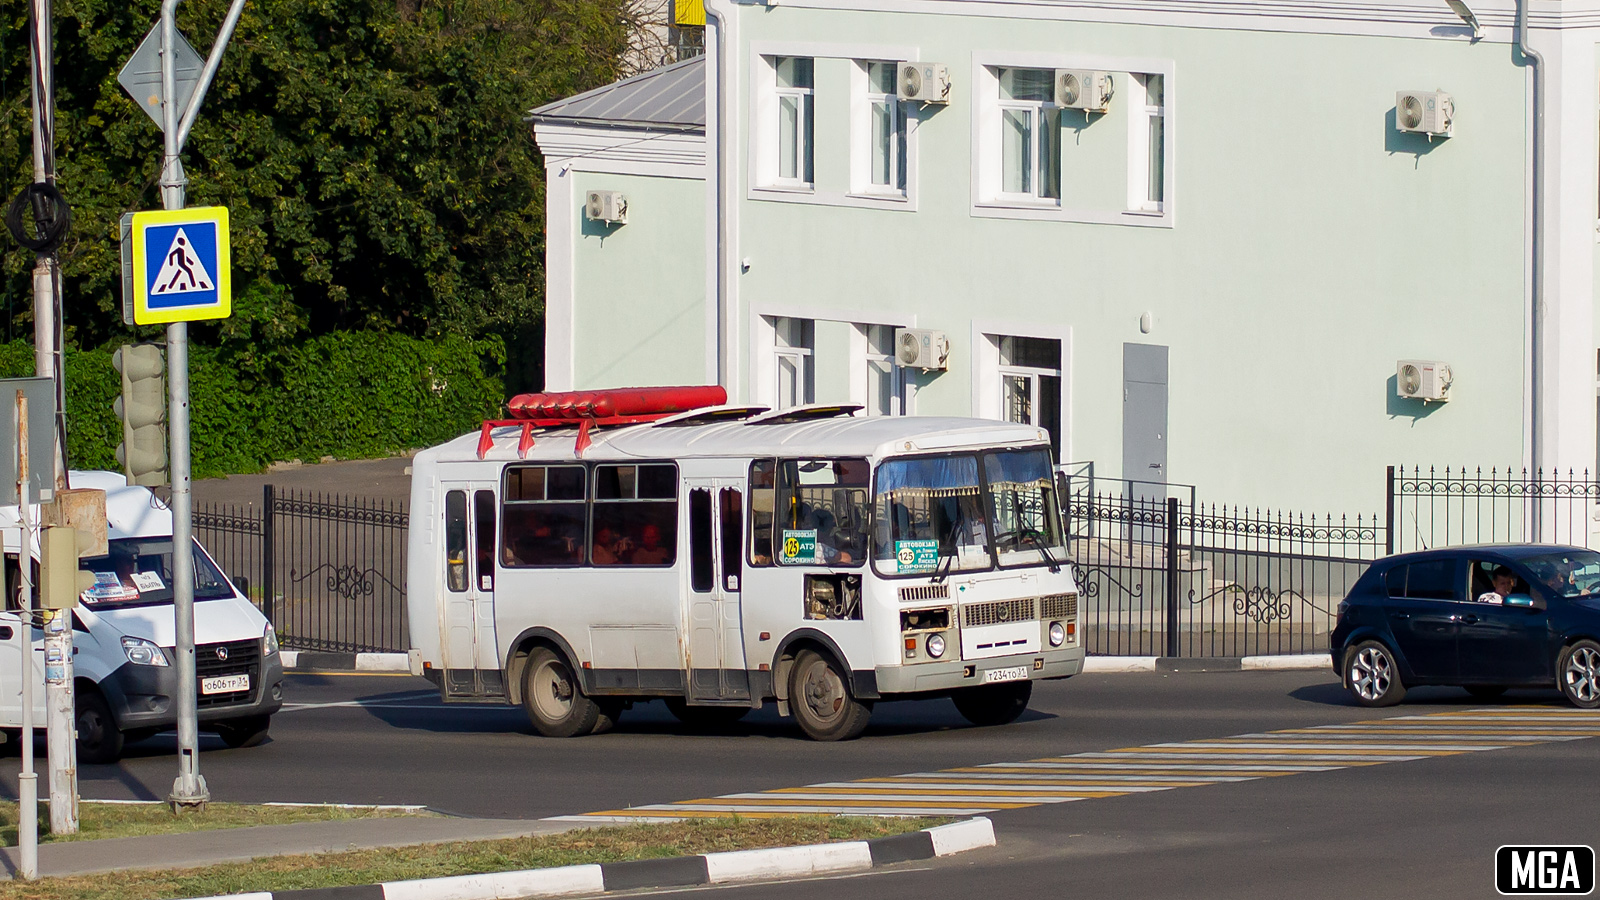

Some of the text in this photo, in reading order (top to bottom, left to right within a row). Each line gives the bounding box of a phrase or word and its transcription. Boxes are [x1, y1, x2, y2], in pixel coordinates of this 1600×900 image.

[785, 540, 798, 555] 125
[899, 552, 914, 561] 125
[988, 670, 1017, 680] Т234ТО
